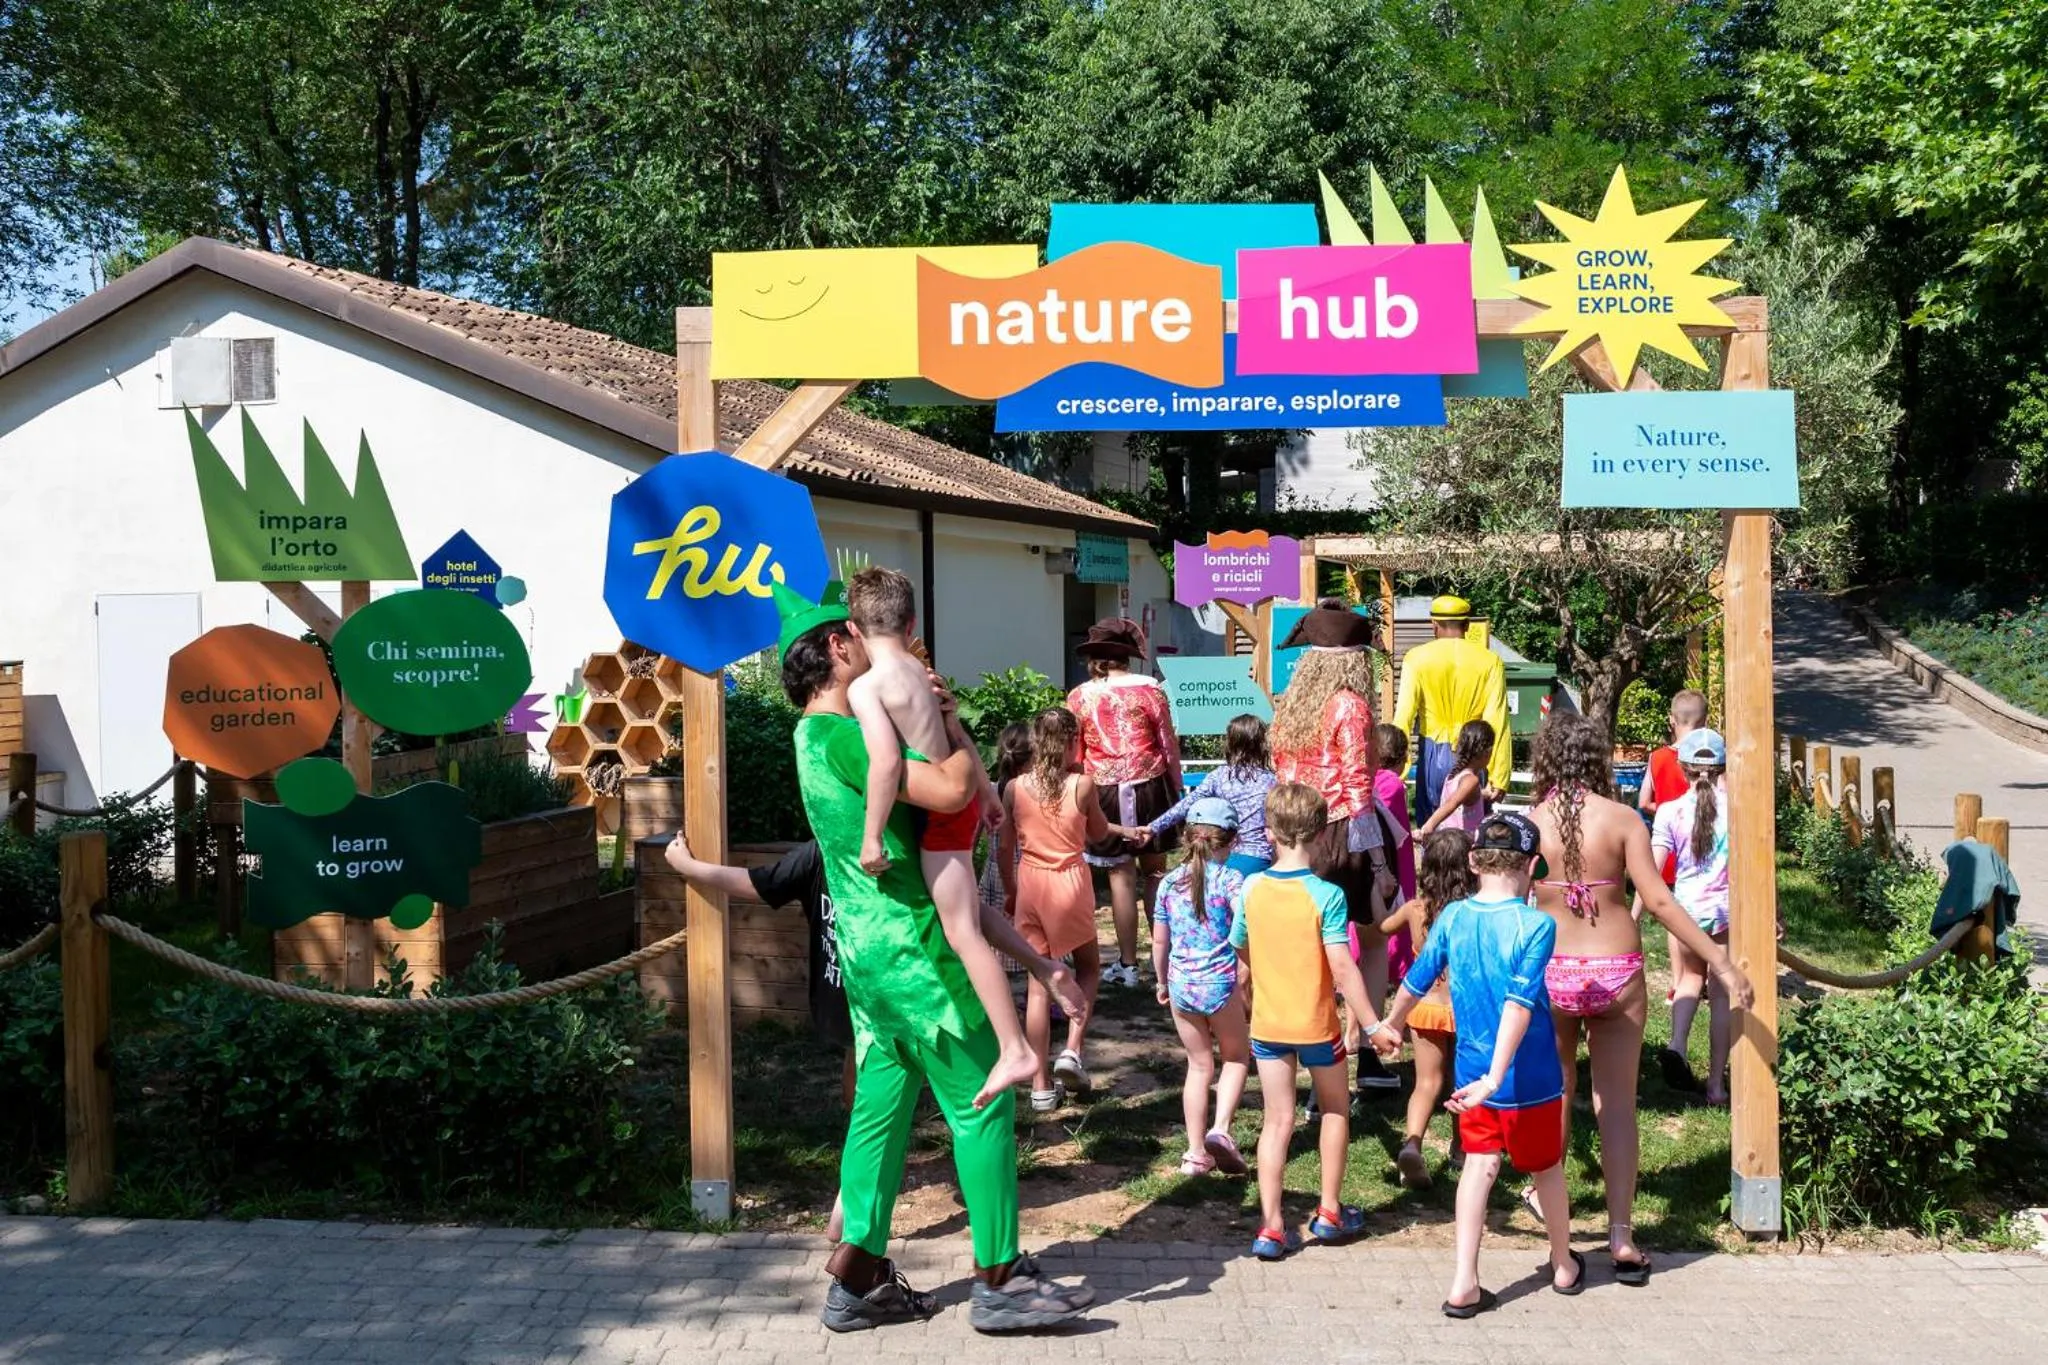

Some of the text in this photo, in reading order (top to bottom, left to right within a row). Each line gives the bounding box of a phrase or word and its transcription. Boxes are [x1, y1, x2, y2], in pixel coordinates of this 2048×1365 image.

[1576, 249, 1653, 270] GROW,
[1577, 273, 1655, 293] LEARN,
[1279, 276, 1419, 340] hub
[1578, 296, 1674, 314] EXPLORE
[950, 288, 1192, 345] nature
[1056, 389, 1401, 416] crescere, imparare, esplorare
[1635, 424, 1727, 450] Nature,
[1592, 451, 1771, 480] in every sense.
[259, 509, 348, 534] impara
[271, 536, 338, 557] l'orto
[446, 560, 478, 572] hotel
[1203, 551, 1271, 566] lombrichi
[426, 572, 497, 586] degli insetti
[1211, 569, 1263, 583] e ricicli
[366, 639, 506, 661] Chi semina,
[393, 662, 480, 688] scopre!
[180, 681, 324, 704] educational
[1179, 679, 1238, 694] compost
[1175, 693, 1255, 708] earthworms
[210, 707, 296, 733] garden
[332, 834, 388, 853] learn
[316, 858, 404, 879] to grow
